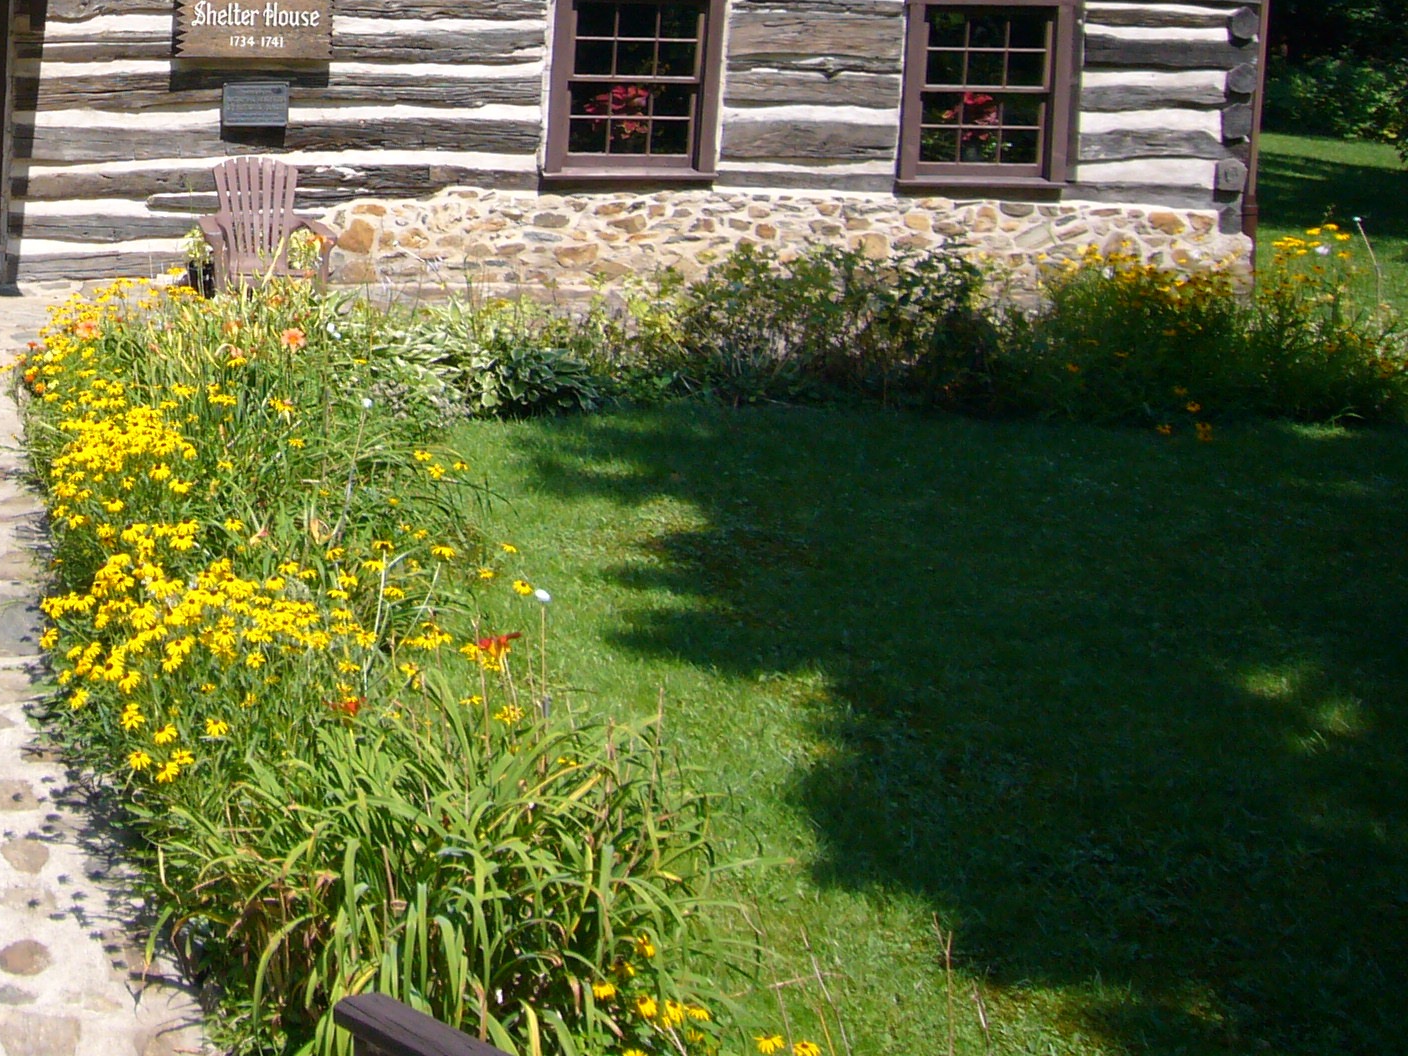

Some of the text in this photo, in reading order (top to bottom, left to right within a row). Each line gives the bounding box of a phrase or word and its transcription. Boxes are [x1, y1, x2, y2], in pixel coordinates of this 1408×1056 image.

[191, 0, 320, 27] Shelter House
[230, 35, 284, 48] 1734 1741
